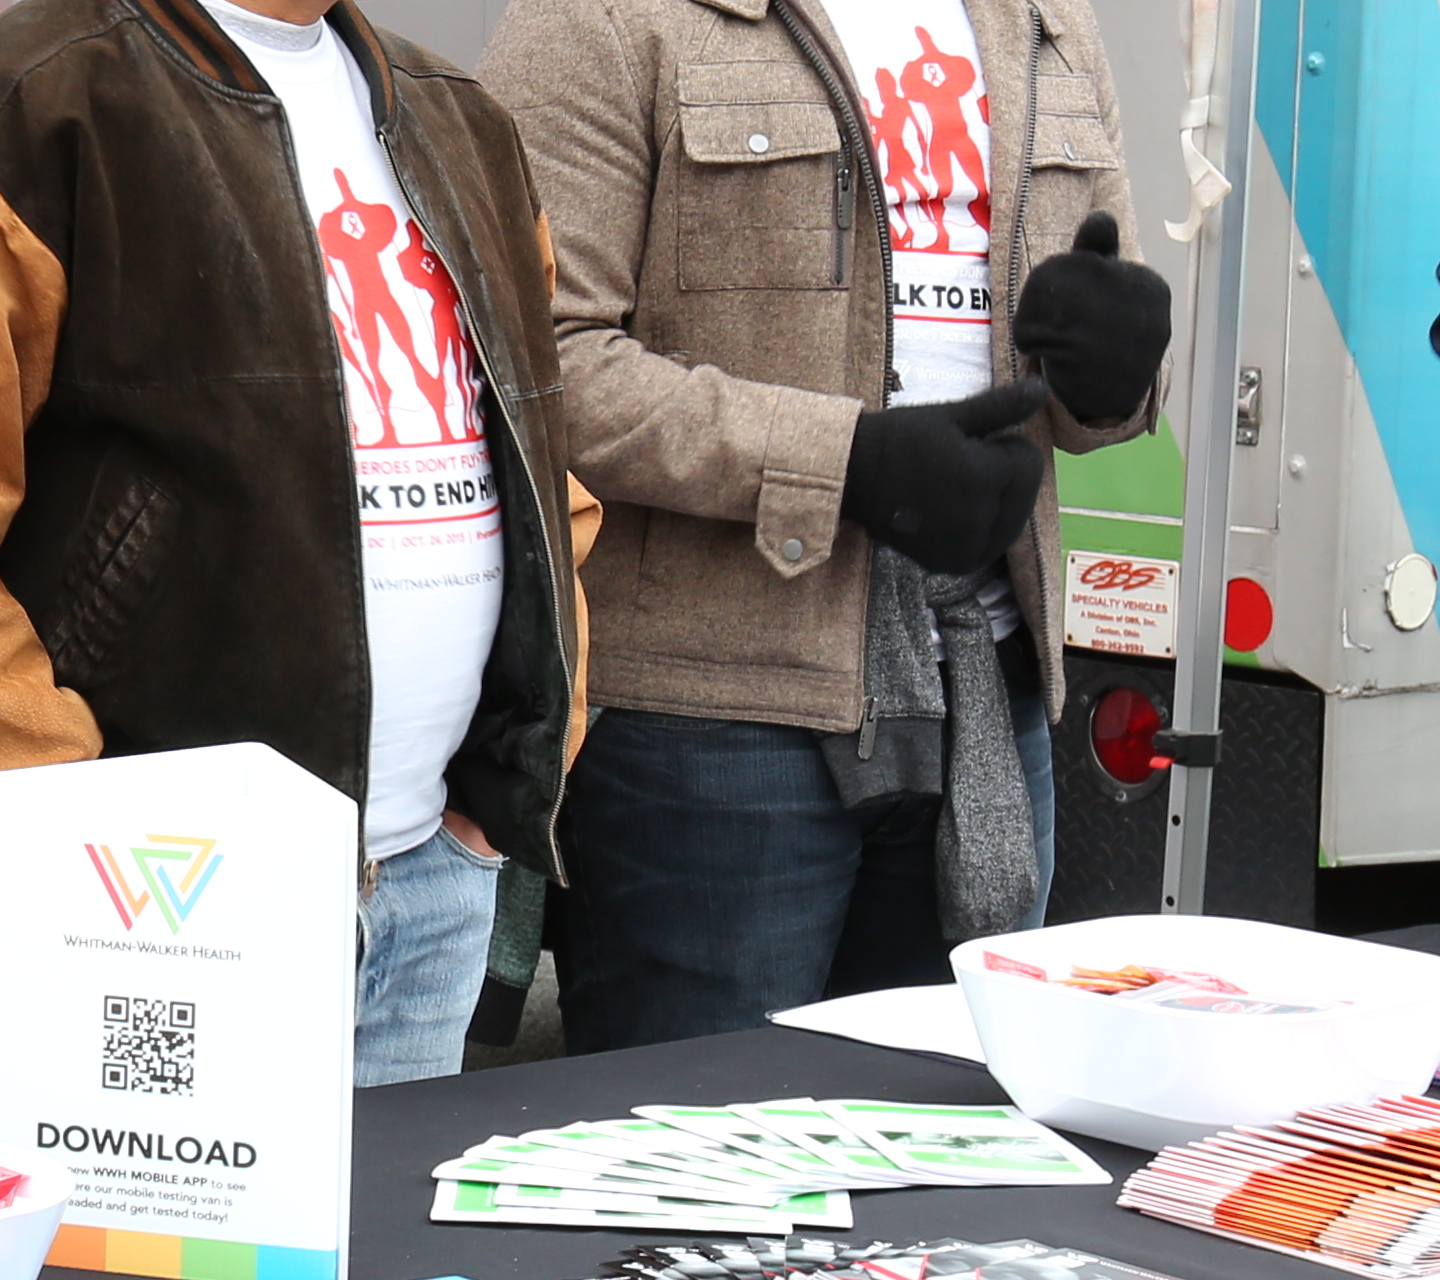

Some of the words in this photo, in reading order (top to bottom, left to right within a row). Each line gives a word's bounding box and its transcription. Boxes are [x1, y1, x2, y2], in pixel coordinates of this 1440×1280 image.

[932, 286, 964, 309] TO
[416, 456, 457, 472] DON'T
[389, 484, 426, 508] TO
[434, 480, 475, 506] END
[1081, 560, 1162, 591] OBS
[1072, 593, 1121, 608] SPECIALTY
[1122, 599, 1168, 614] VEHICLES
[1087, 611, 1114, 621] Division
[1116, 615, 1123, 623] of
[1124, 629, 1140, 638] Ohio
[63, 933, 188, 959] WHITMAN-WALKER
[193, 946, 242, 962] HEALTH
[37, 1122, 257, 1168] DOWNLOAD
[93, 1166, 127, 1179] WWH
[131, 1170, 178, 1185] MOBILE
[183, 1176, 208, 1187] APP
[211, 1179, 223, 1189] to
[227, 1183, 246, 1192] see
[94, 1185, 113, 1195] our
[116, 1185, 155, 1198] mobile
[158, 1190, 197, 1205] testing
[201, 1195, 221, 1206] van
[224, 1195, 233, 1206] is
[106, 1199, 127, 1212] and
[130, 1204, 149, 1216] get
[152, 1205, 189, 1218] tested
[192, 1210, 228, 1225] today!
